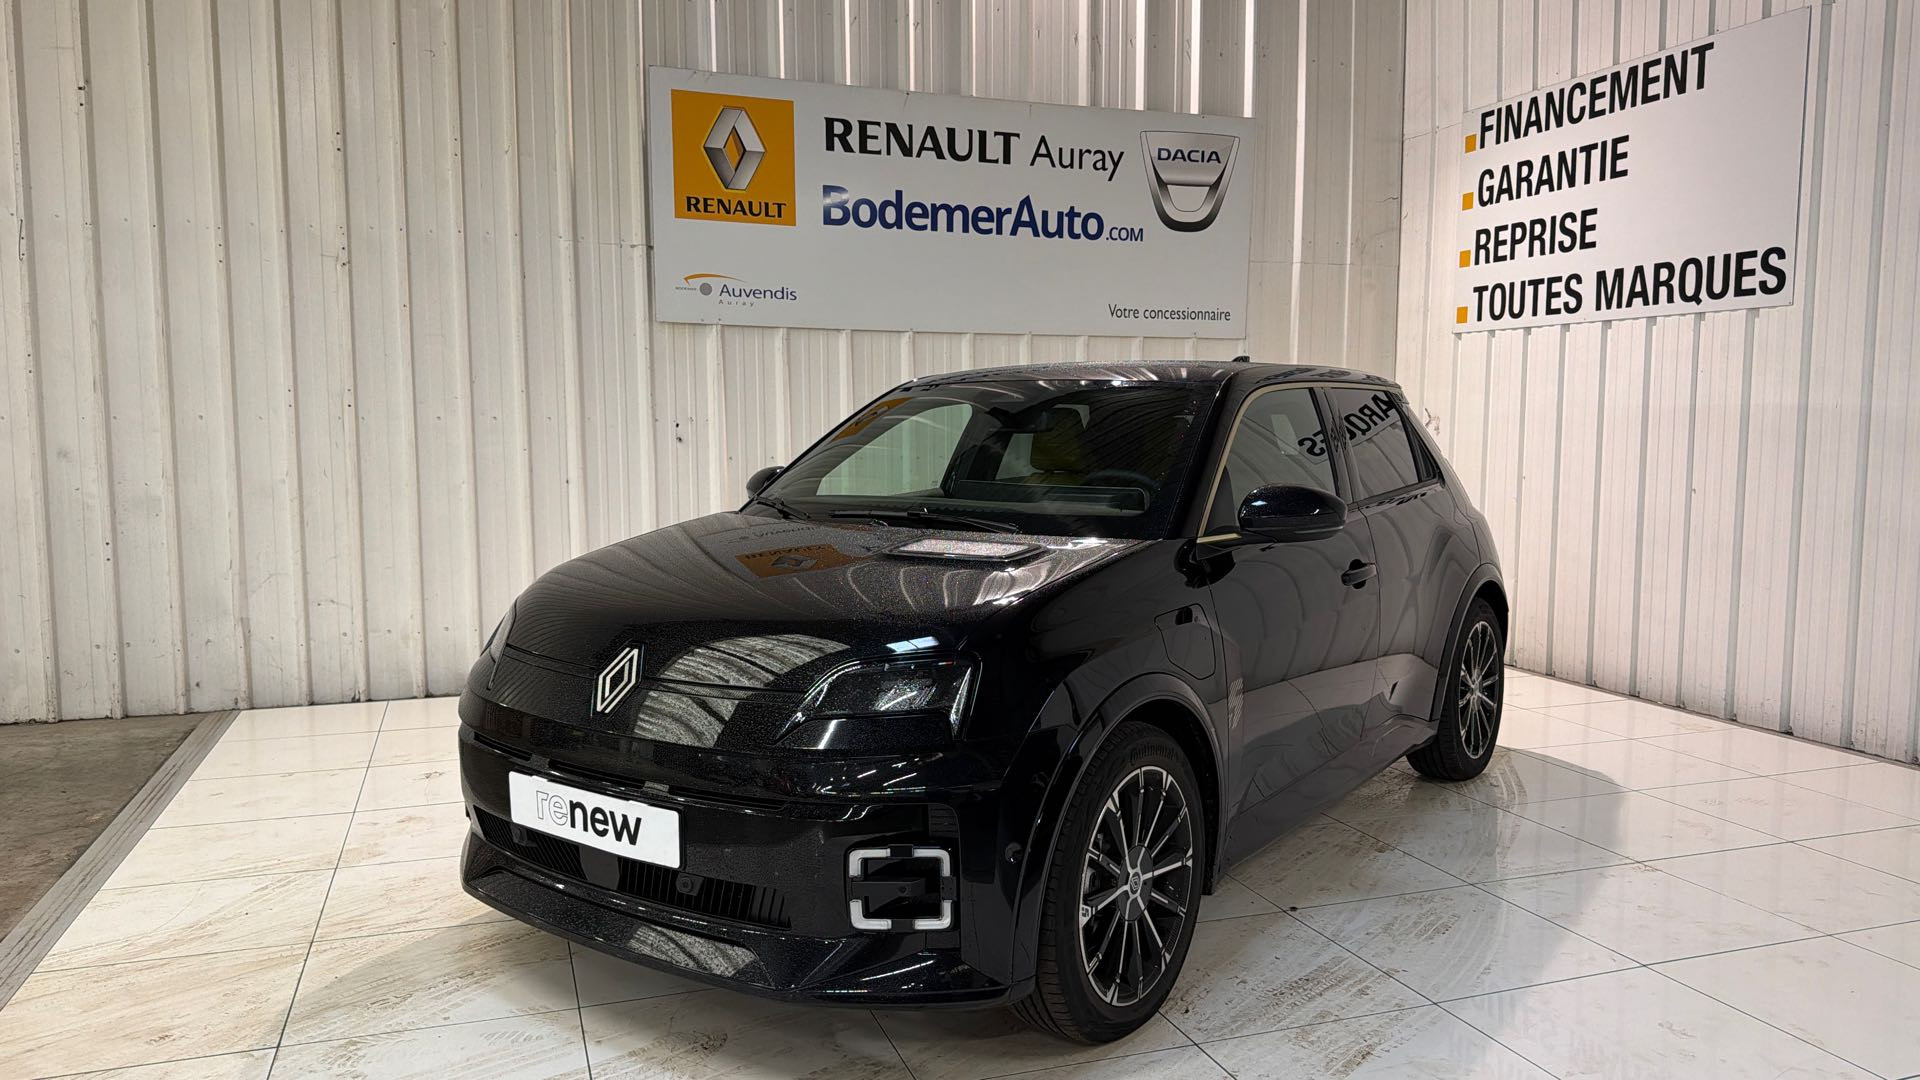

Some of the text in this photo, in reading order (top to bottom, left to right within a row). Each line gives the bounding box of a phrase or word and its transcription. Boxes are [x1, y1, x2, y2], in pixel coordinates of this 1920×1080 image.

[1479, 41, 1715, 150] FINANCEMENT
[824, 117, 1125, 182] RENAULT Auray
[1156, 147, 1222, 165] DACIA
[1477, 134, 1630, 207] GARANTIE
[686, 195, 786, 219] RENAULT
[1474, 207, 1598, 266] REPRISE
[719, 284, 798, 301] Auvendis
[1108, 304, 1231, 321] Votre concessionnaire
[1473, 246, 1787, 322] TOUTES MARQUES
[536, 791, 642, 846] renew
